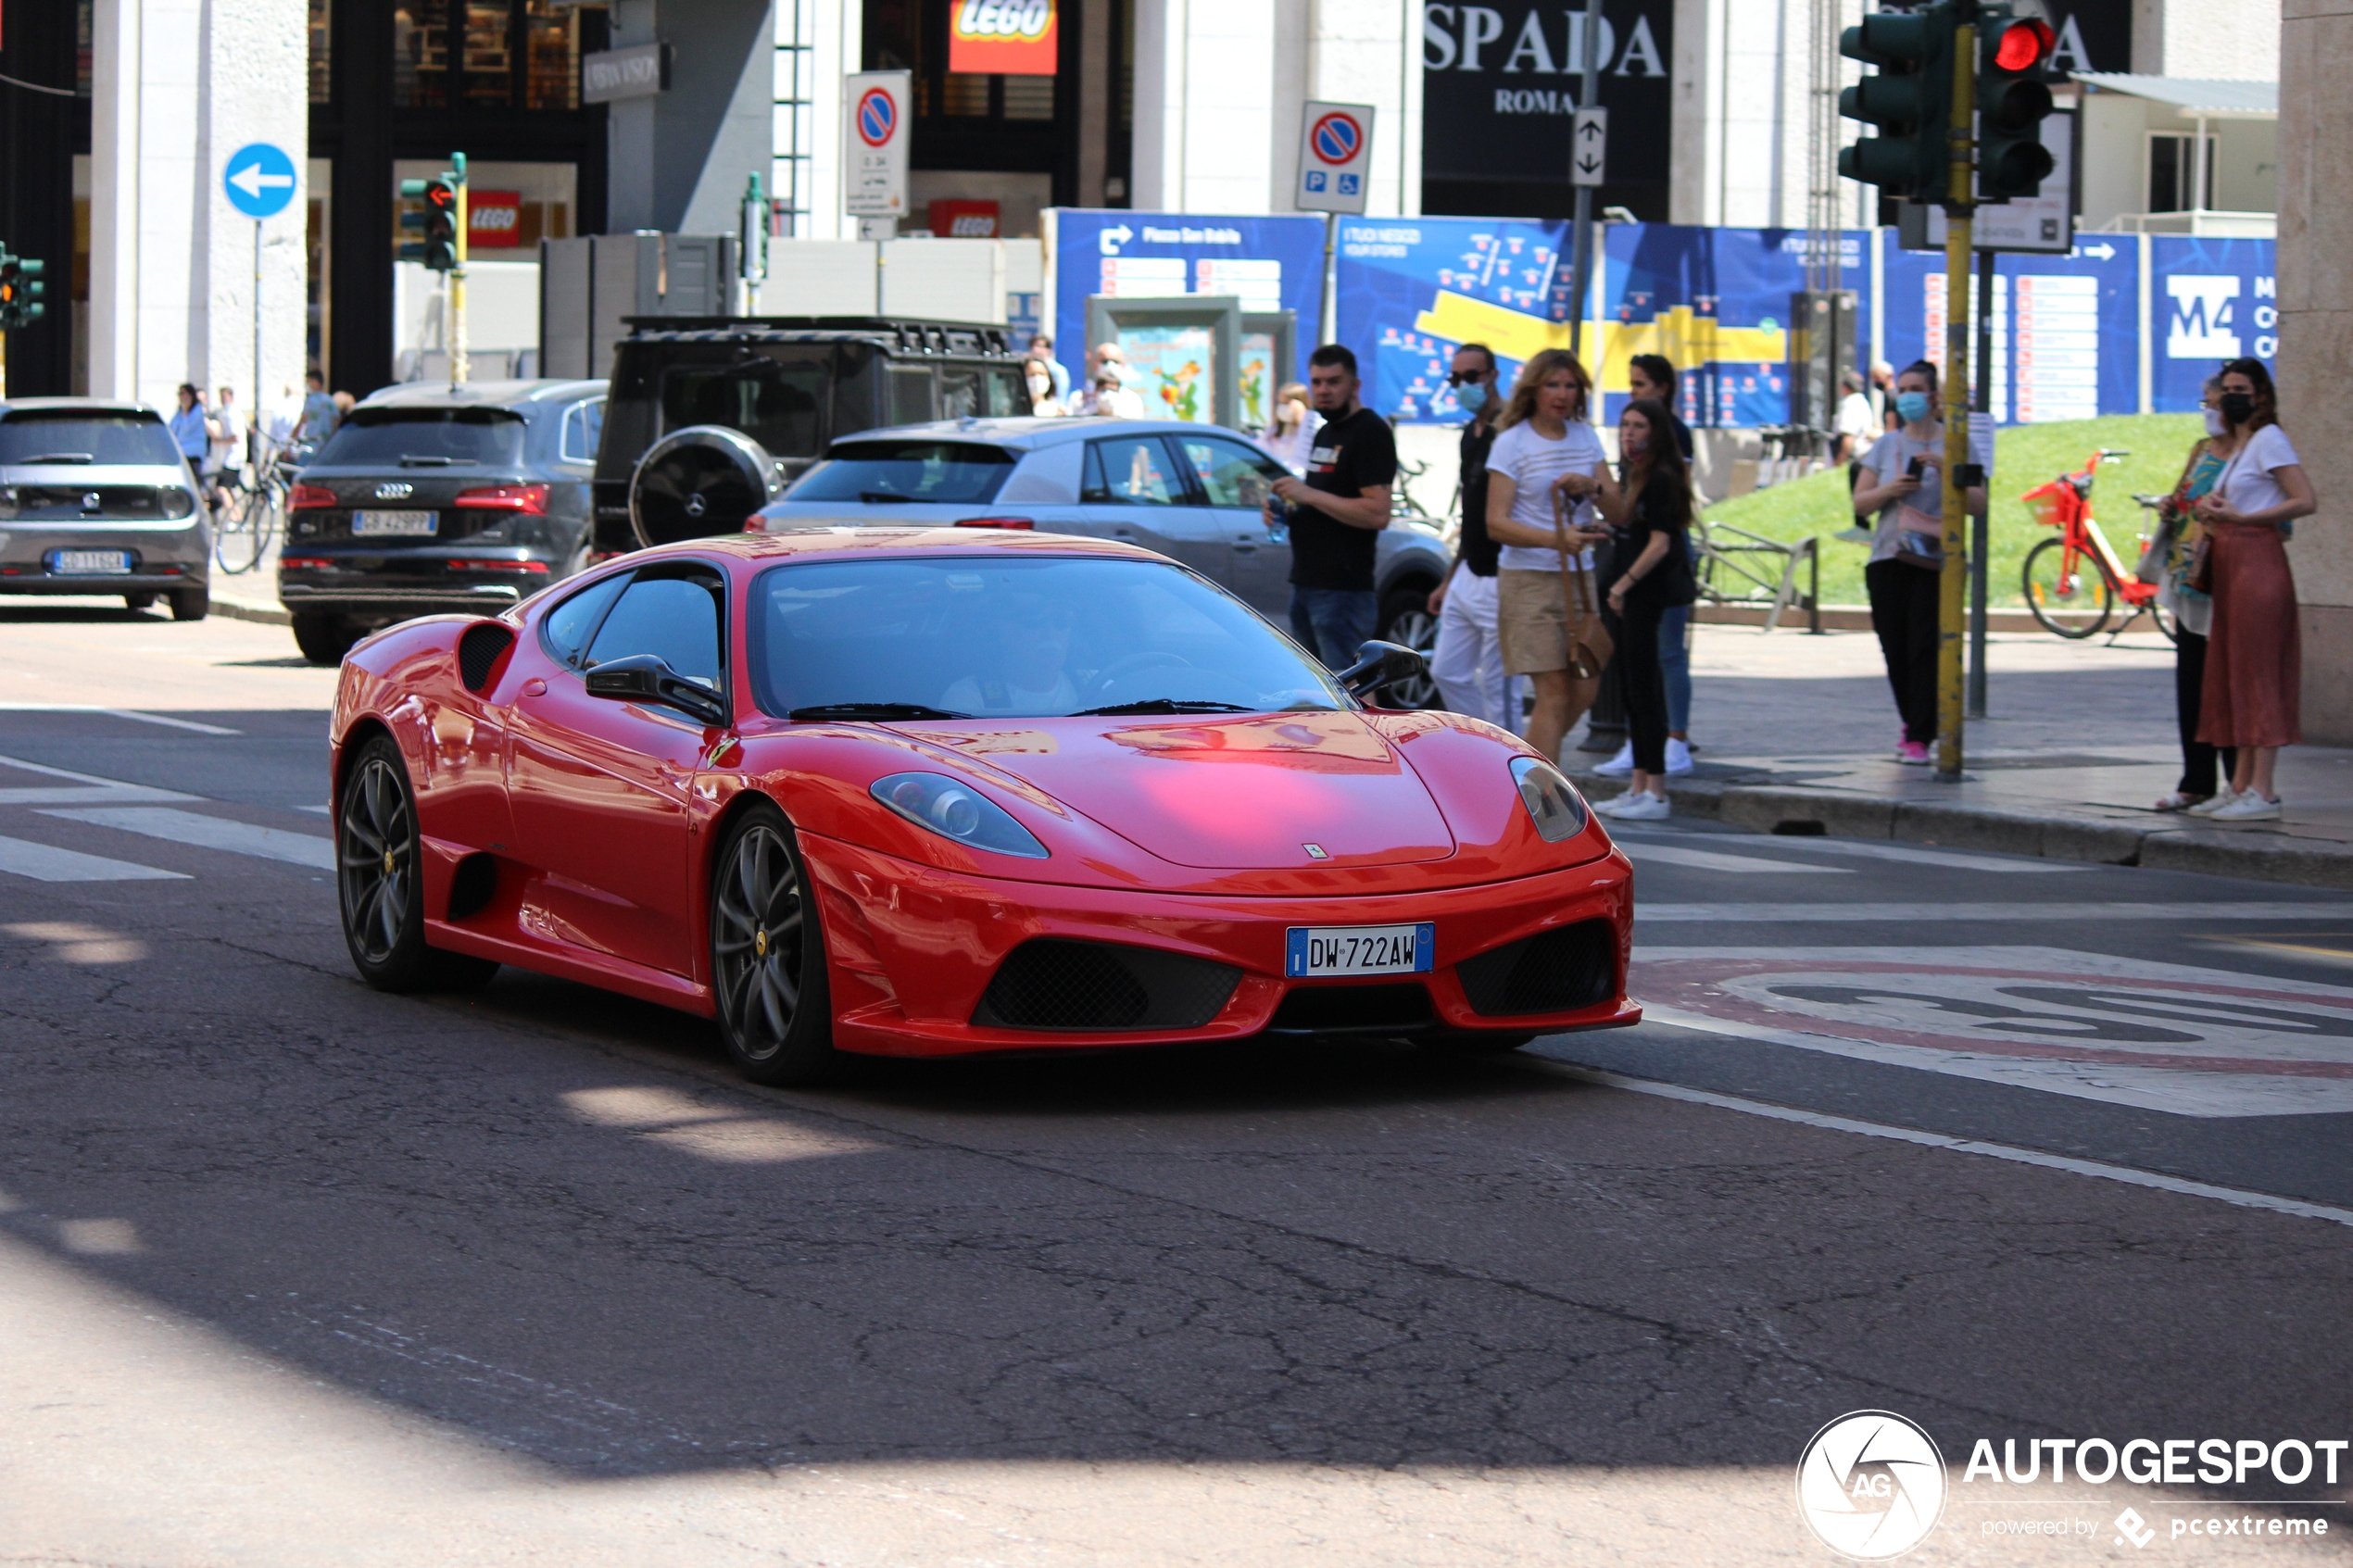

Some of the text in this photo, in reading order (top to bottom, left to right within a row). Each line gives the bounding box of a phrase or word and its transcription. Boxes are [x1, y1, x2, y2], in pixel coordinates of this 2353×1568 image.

[958, 0, 1050, 35] LEGO
[1424, 4, 1667, 77] SPADA
[1494, 89, 1576, 115] ROMA
[471, 207, 517, 231] LEGO
[950, 216, 996, 237] LEGO
